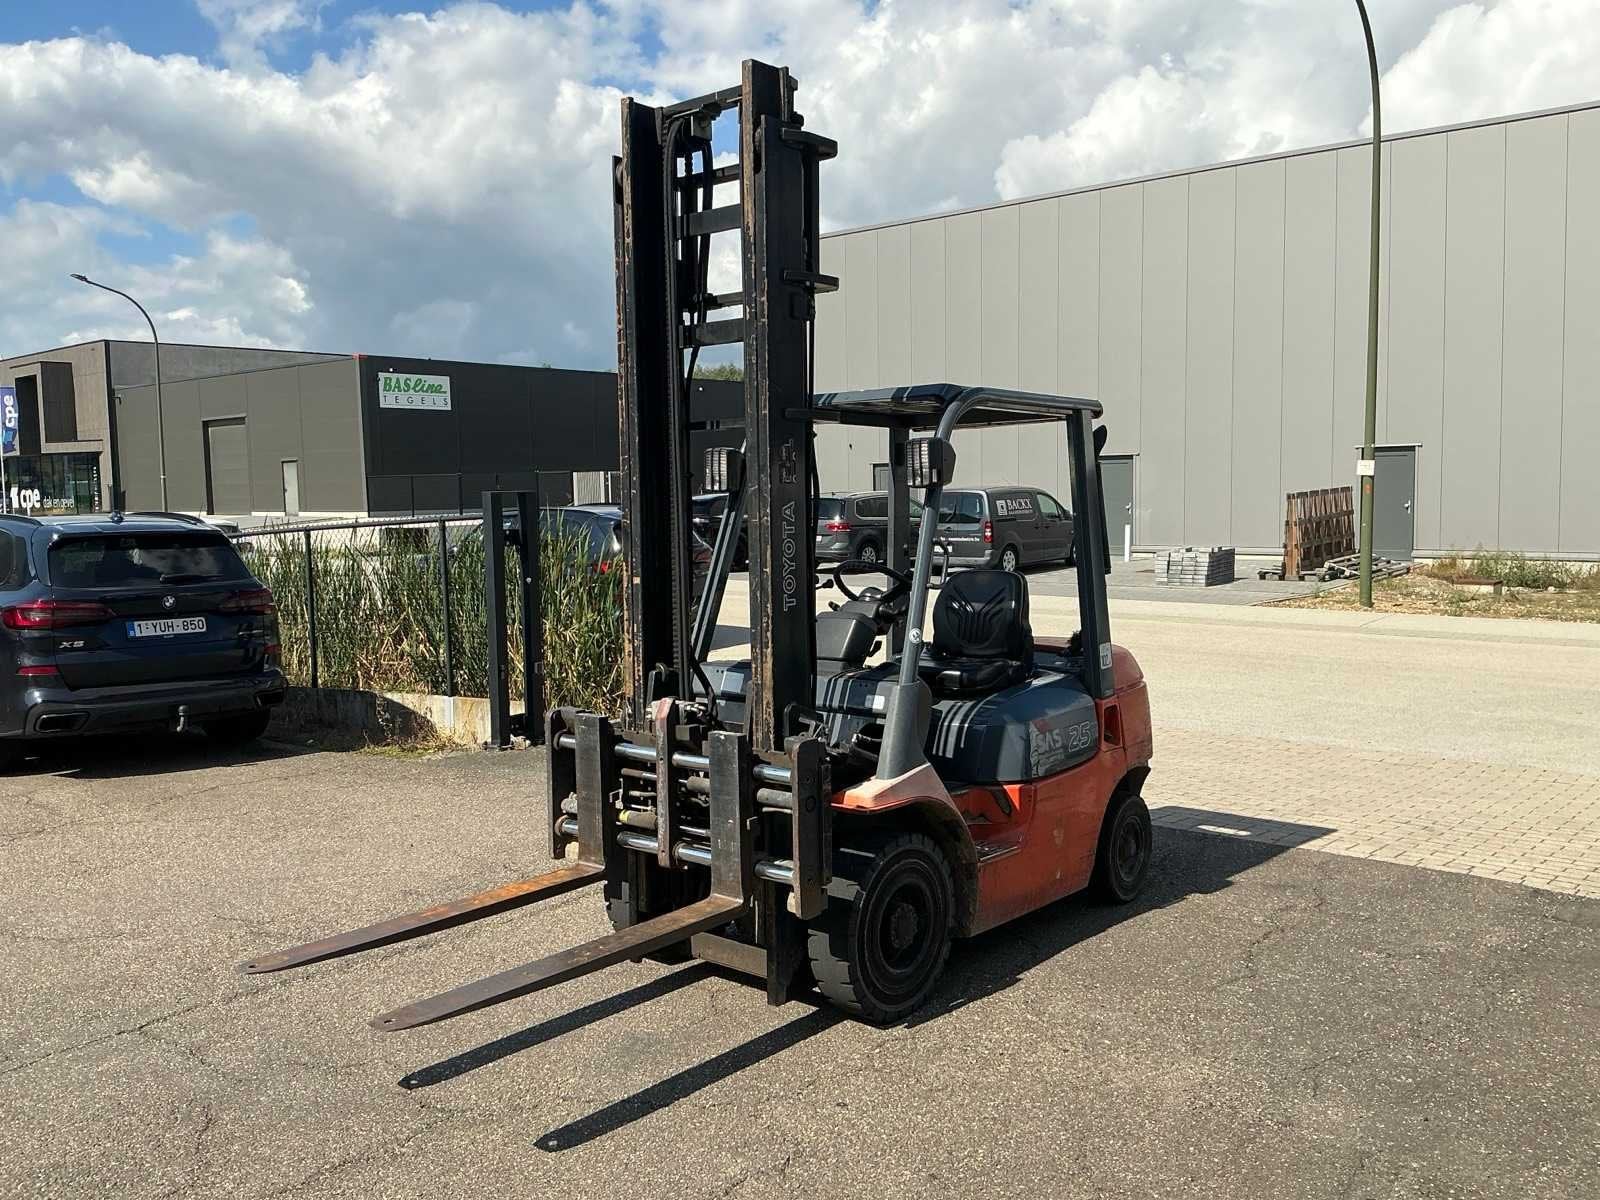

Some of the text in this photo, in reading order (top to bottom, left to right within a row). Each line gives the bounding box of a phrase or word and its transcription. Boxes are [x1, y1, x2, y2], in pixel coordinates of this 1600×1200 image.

[4, 394, 18, 427] cpe
[383, 395, 448, 406] TEGELS
[20, 488, 40, 517] cpe
[1007, 498, 1032, 509] BACKX
[783, 501, 796, 611] TOYOTA
[136, 619, 205, 634] 1-YUH-850
[59, 640, 84, 648] X5
[1068, 721, 1090, 752] 25
